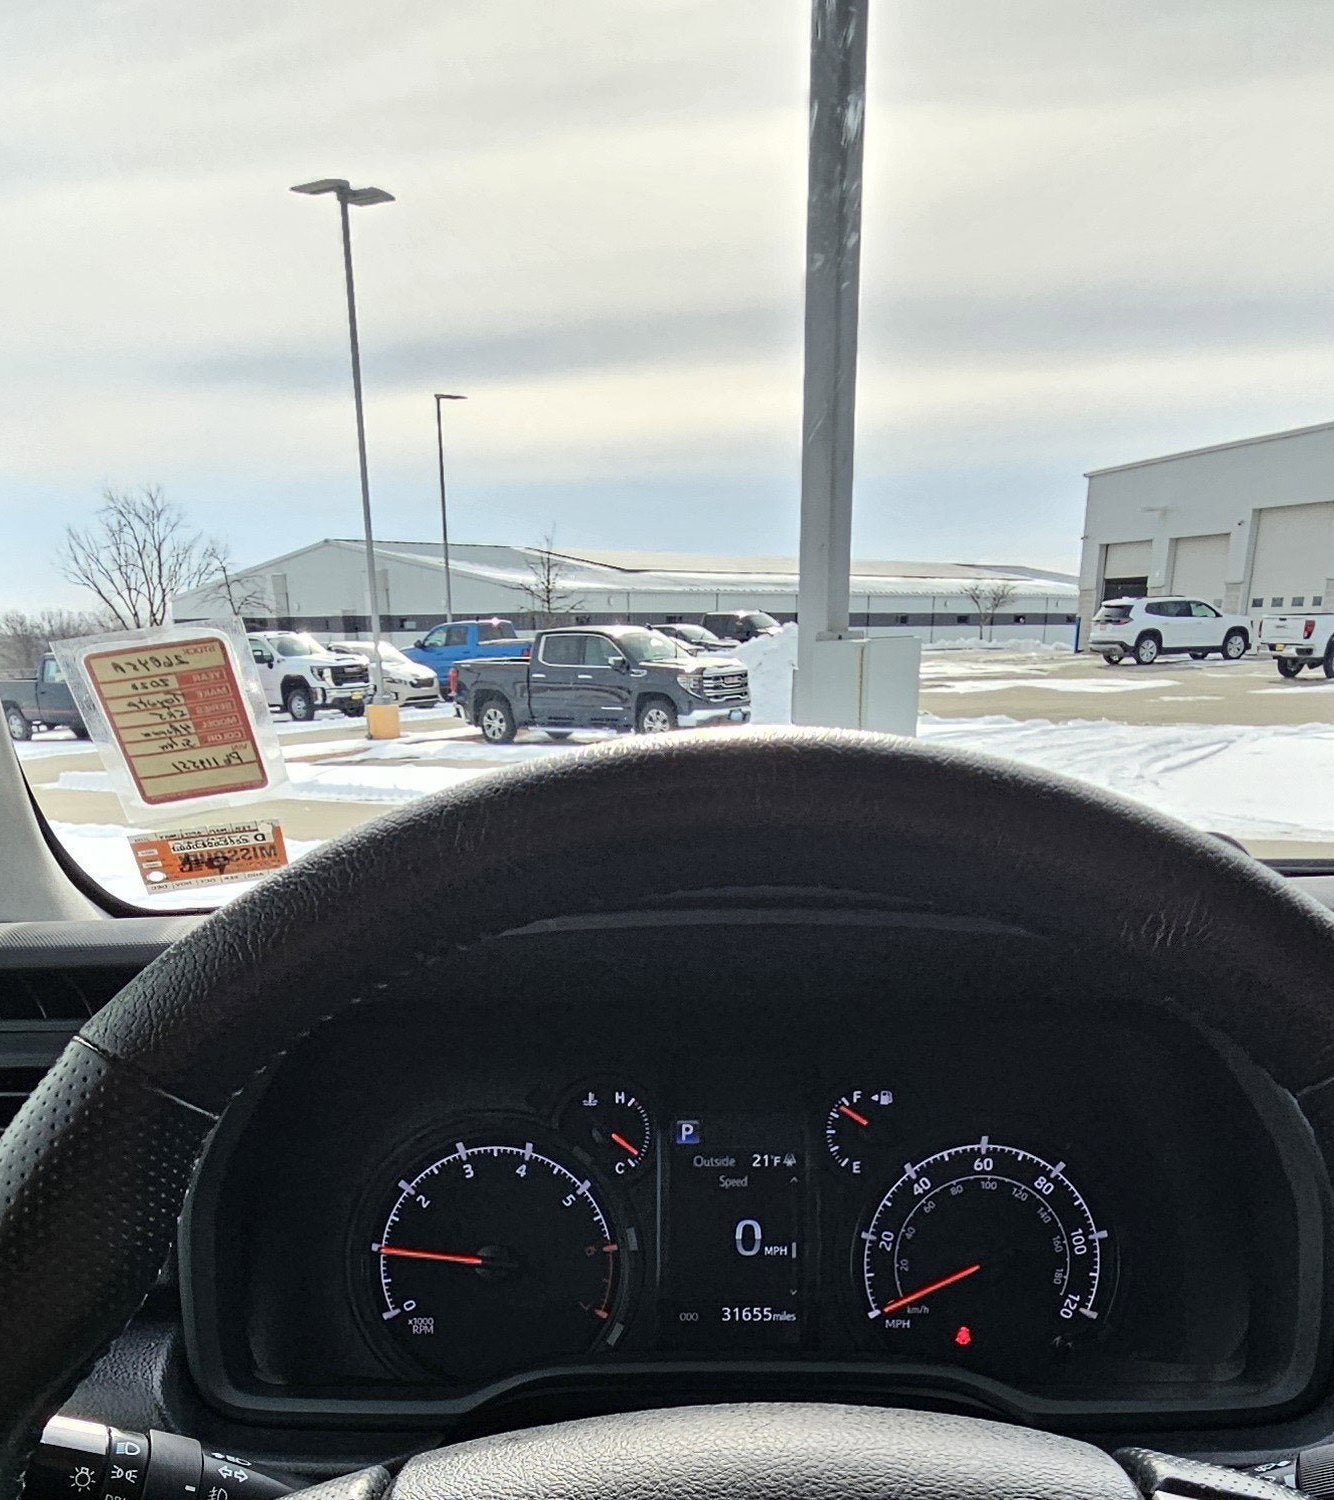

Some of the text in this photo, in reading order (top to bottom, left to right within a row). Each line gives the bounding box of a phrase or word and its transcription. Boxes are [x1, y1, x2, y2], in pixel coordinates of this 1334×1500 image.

[615, 1092, 626, 1104] H
[853, 1091, 863, 1103] F
[681, 1123, 694, 1141] P
[615, 1162, 626, 1175] C
[693, 1155, 736, 1168] Outside
[852, 1161, 861, 1174] E
[973, 1158, 994, 1171] 60
[463, 1164, 475, 1178] 3
[515, 1164, 527, 1178] 4
[719, 1175, 749, 1188] Speed
[913, 1177, 932, 1196] 40
[980, 1180, 998, 1191] 100
[1033, 1176, 1055, 1196] 80
[949, 1184, 964, 1196] 80
[1011, 1186, 1029, 1202] 120
[416, 1194, 431, 1209] 2
[562, 1194, 576, 1207] 5
[922, 1200, 937, 1214] 60
[1036, 1206, 1052, 1225] 140
[735, 1219, 788, 1256] 0 MPH
[905, 1226, 917, 1240] 40
[878, 1230, 896, 1252] 20
[1051, 1234, 1064, 1254] 160
[1069, 1228, 1087, 1256] 100
[900, 1258, 909, 1273] 20
[1053, 1267, 1064, 1286] 180
[402, 1300, 417, 1312] 0
[907, 1304, 930, 1315] km/h
[1059, 1293, 1080, 1320] 120
[721, 1307, 772, 1322] 31655
[772, 1309, 797, 1322] miles
[412, 1324, 434, 1335] RPM
[885, 1319, 911, 1329] MPH
